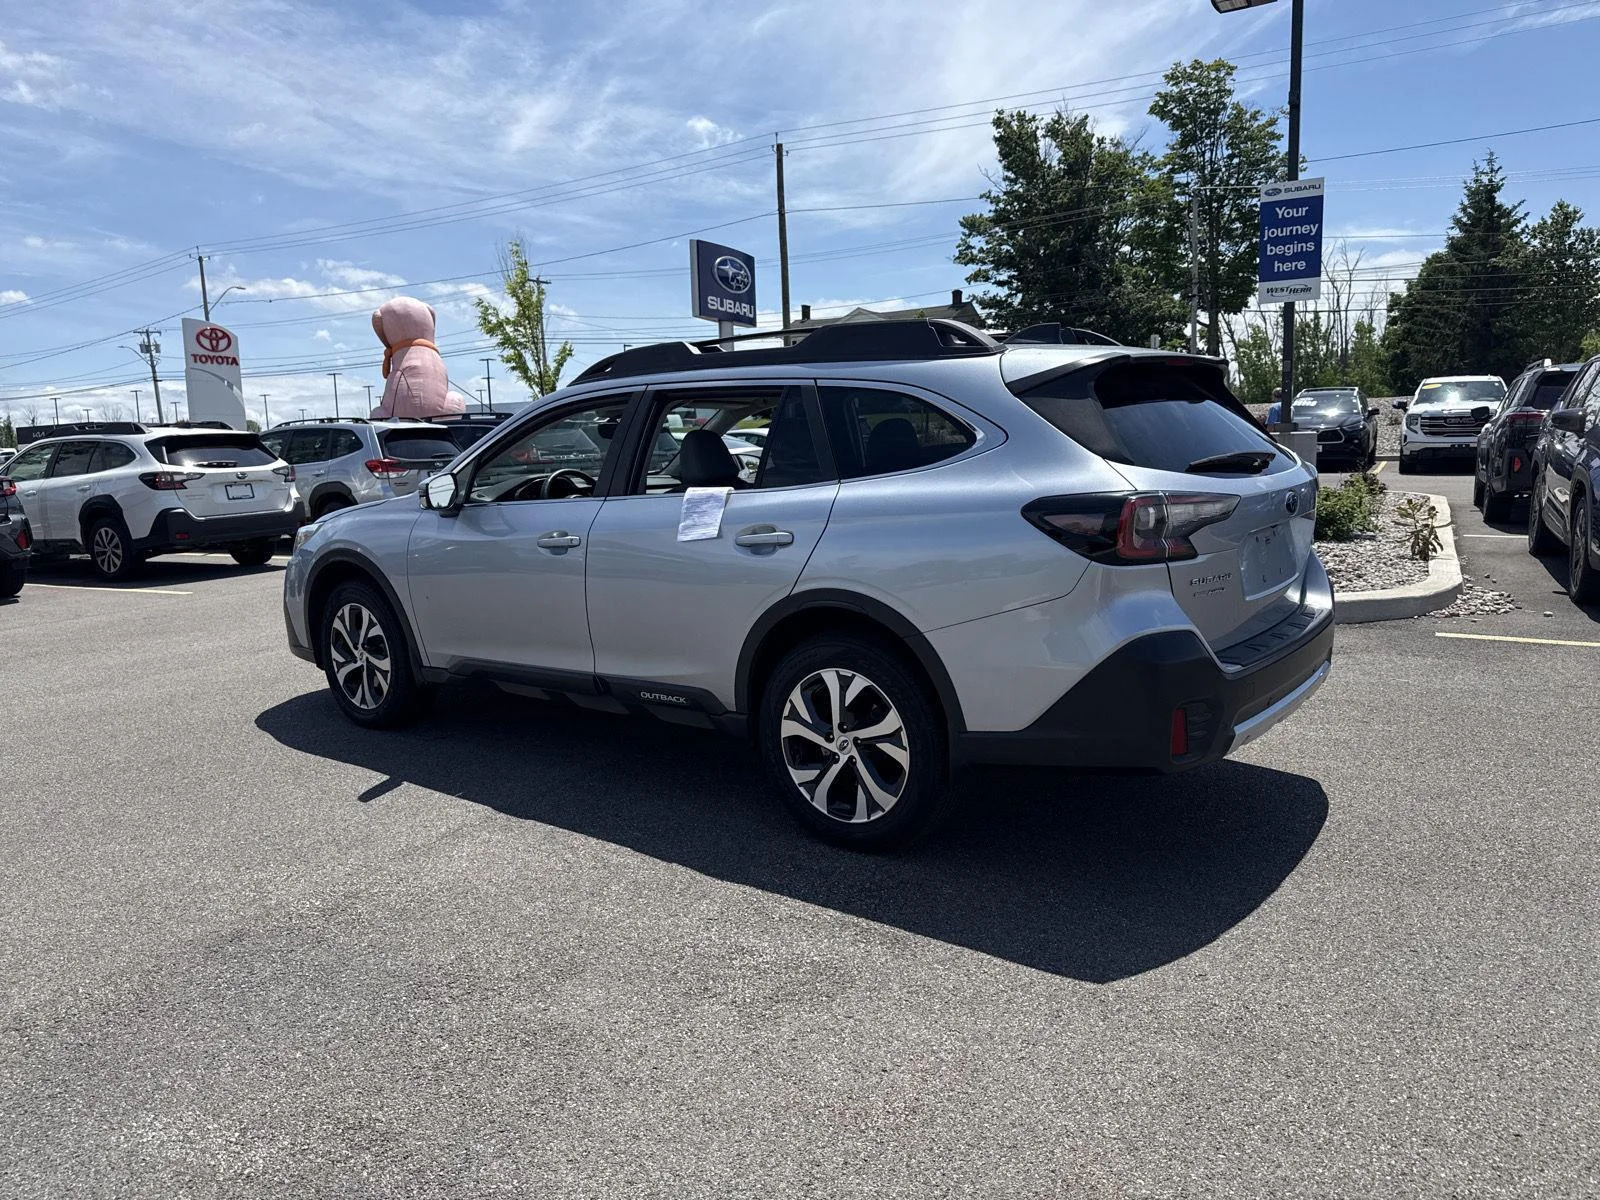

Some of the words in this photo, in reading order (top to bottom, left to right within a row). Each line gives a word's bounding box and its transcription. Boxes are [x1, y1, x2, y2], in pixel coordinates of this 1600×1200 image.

[1284, 184, 1321, 194] SUBARU
[1275, 206, 1309, 219] Your
[1263, 223, 1319, 241] journey
[1266, 241, 1315, 256] begins
[1274, 261, 1306, 272] here
[707, 296, 754, 318] SUBARU
[191, 353, 239, 366] TOYOTA
[640, 691, 686, 704] OUTBACK
